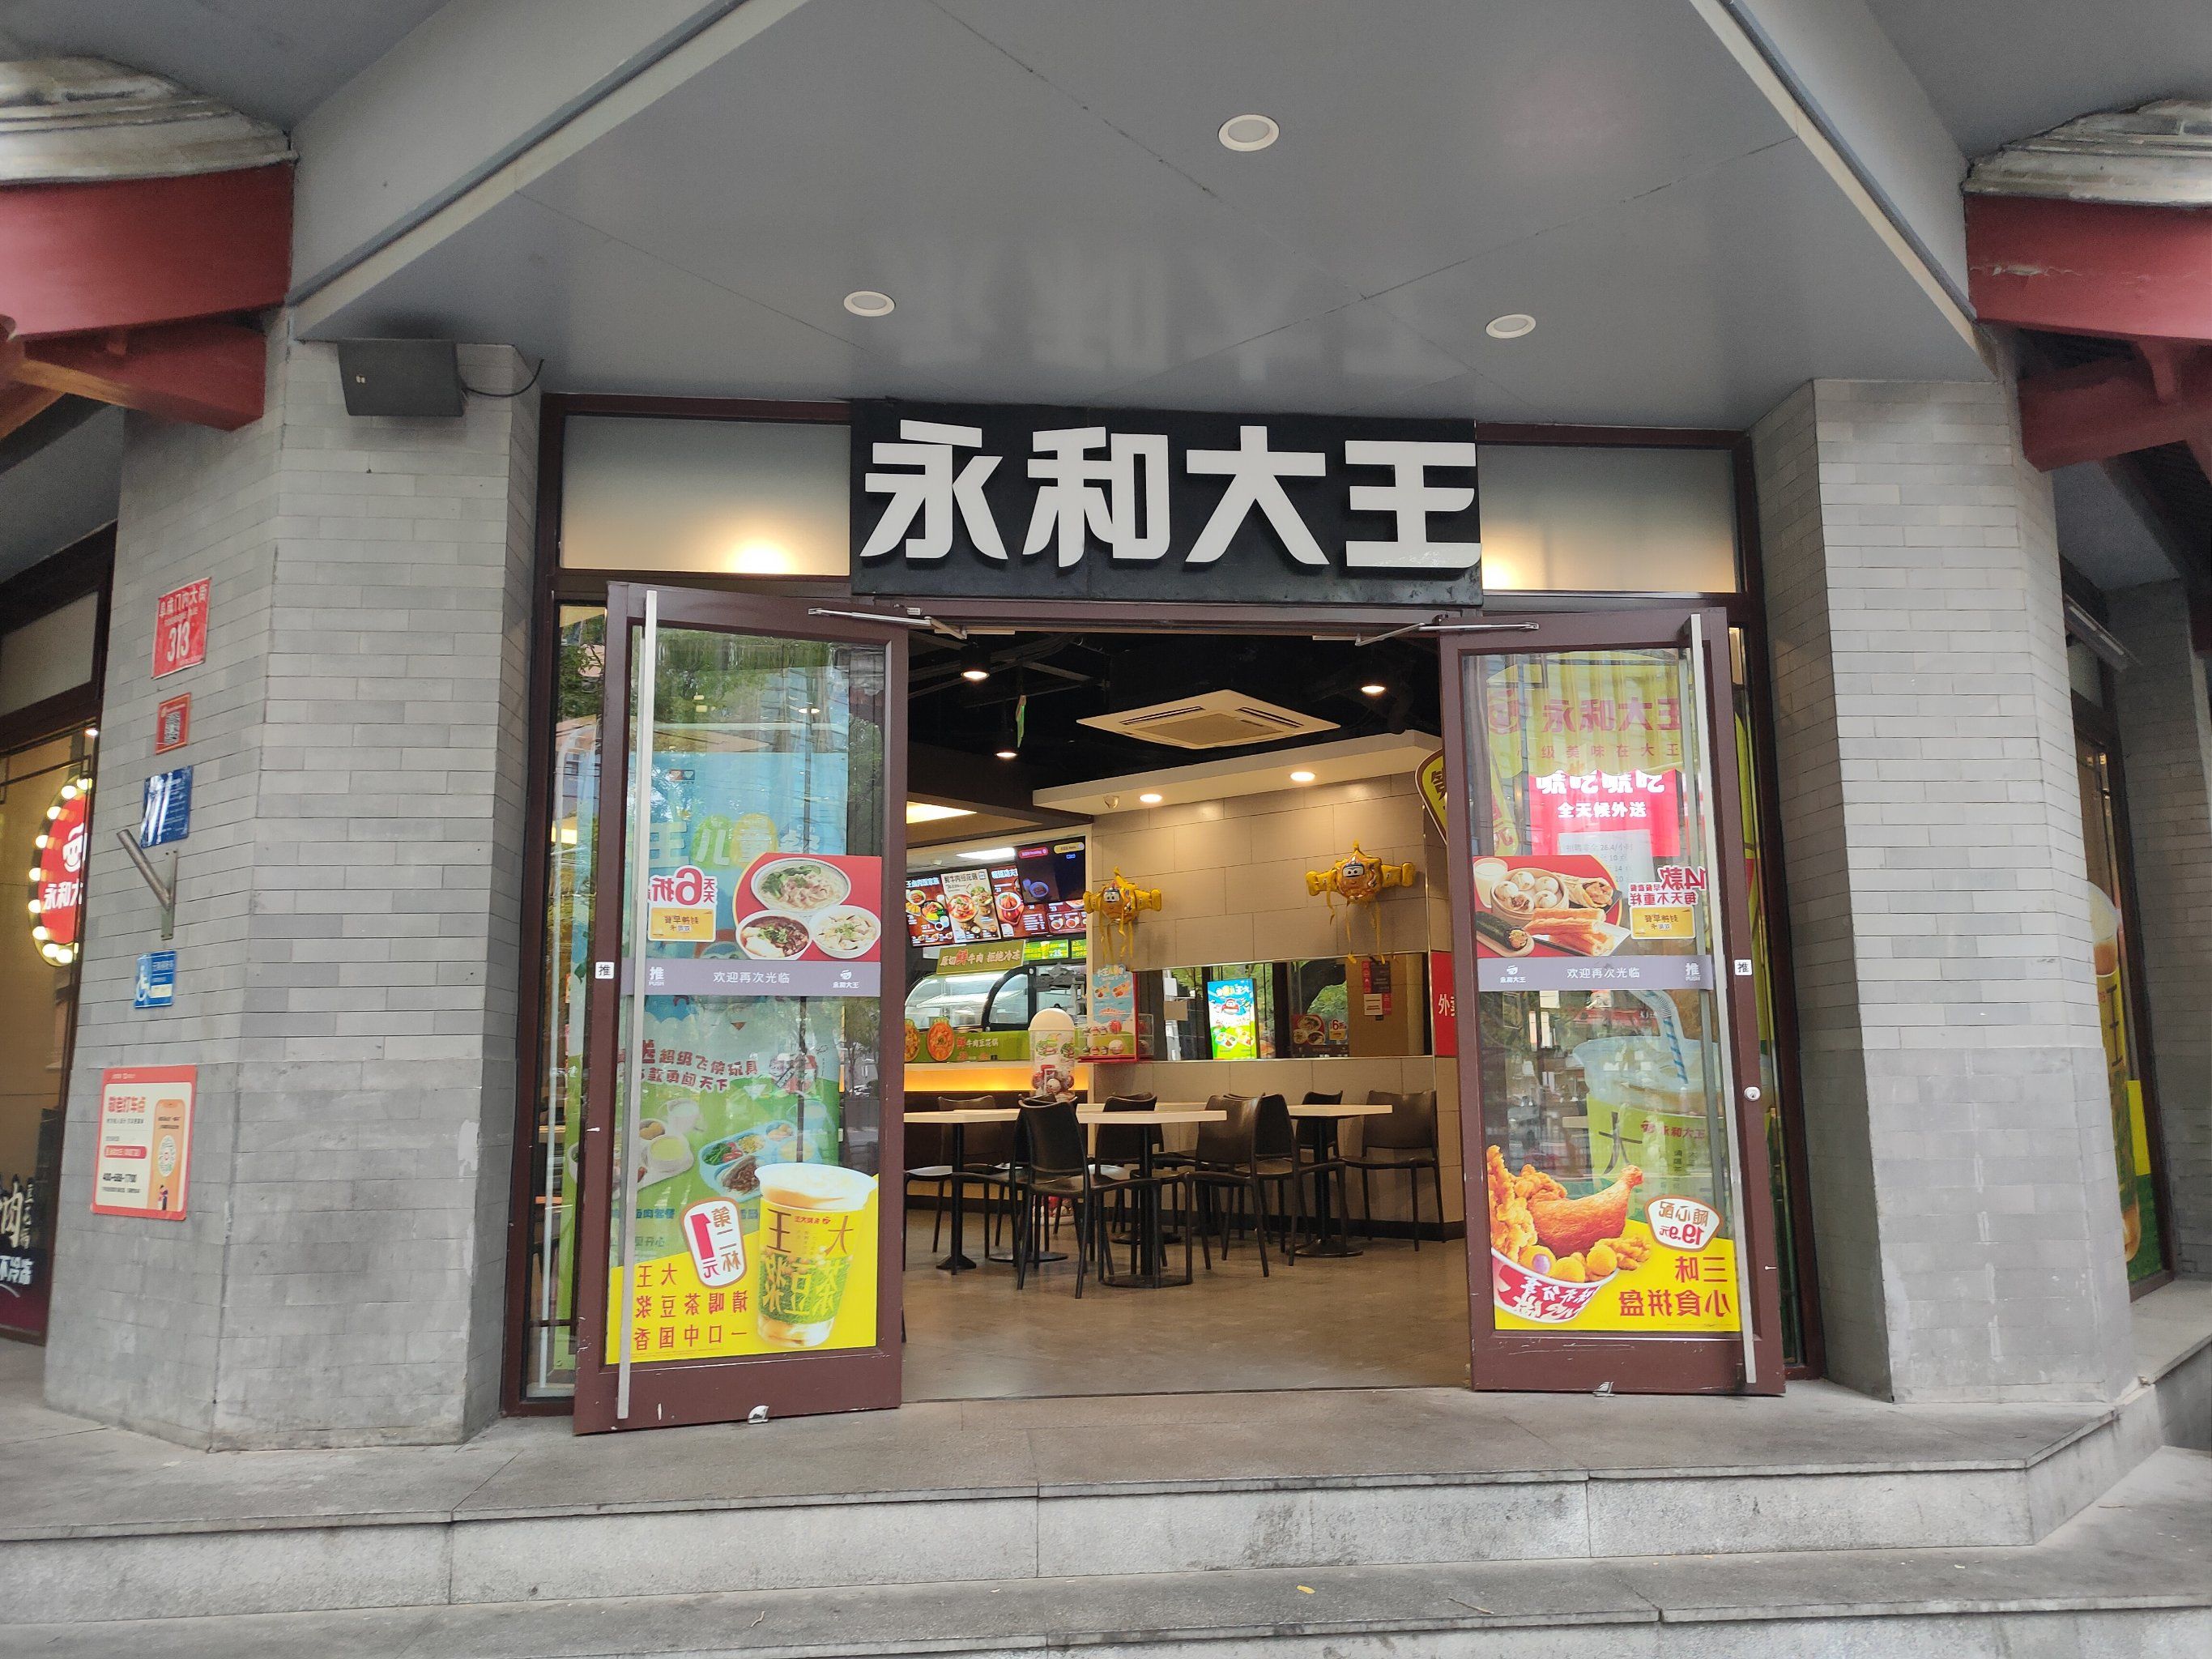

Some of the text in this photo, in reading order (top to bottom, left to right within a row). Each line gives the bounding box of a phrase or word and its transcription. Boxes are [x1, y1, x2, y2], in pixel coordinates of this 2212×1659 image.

[860, 419, 1482, 569] 永和大王
[167, 621, 190, 663] 313
[1542, 697, 1681, 733] 永和大王
[1558, 801, 1647, 818] 全天候外送
[599, 964, 611, 977] 推
[650, 966, 664, 980] 推
[1566, 967, 1640, 979] 欢迎再次光临
[1685, 962, 1700, 976] 推
[1737, 962, 1750, 973] 推
[713, 971, 791, 983] 欢迎再次光临
[641, 1067, 728, 1090] 款勇闯天下
